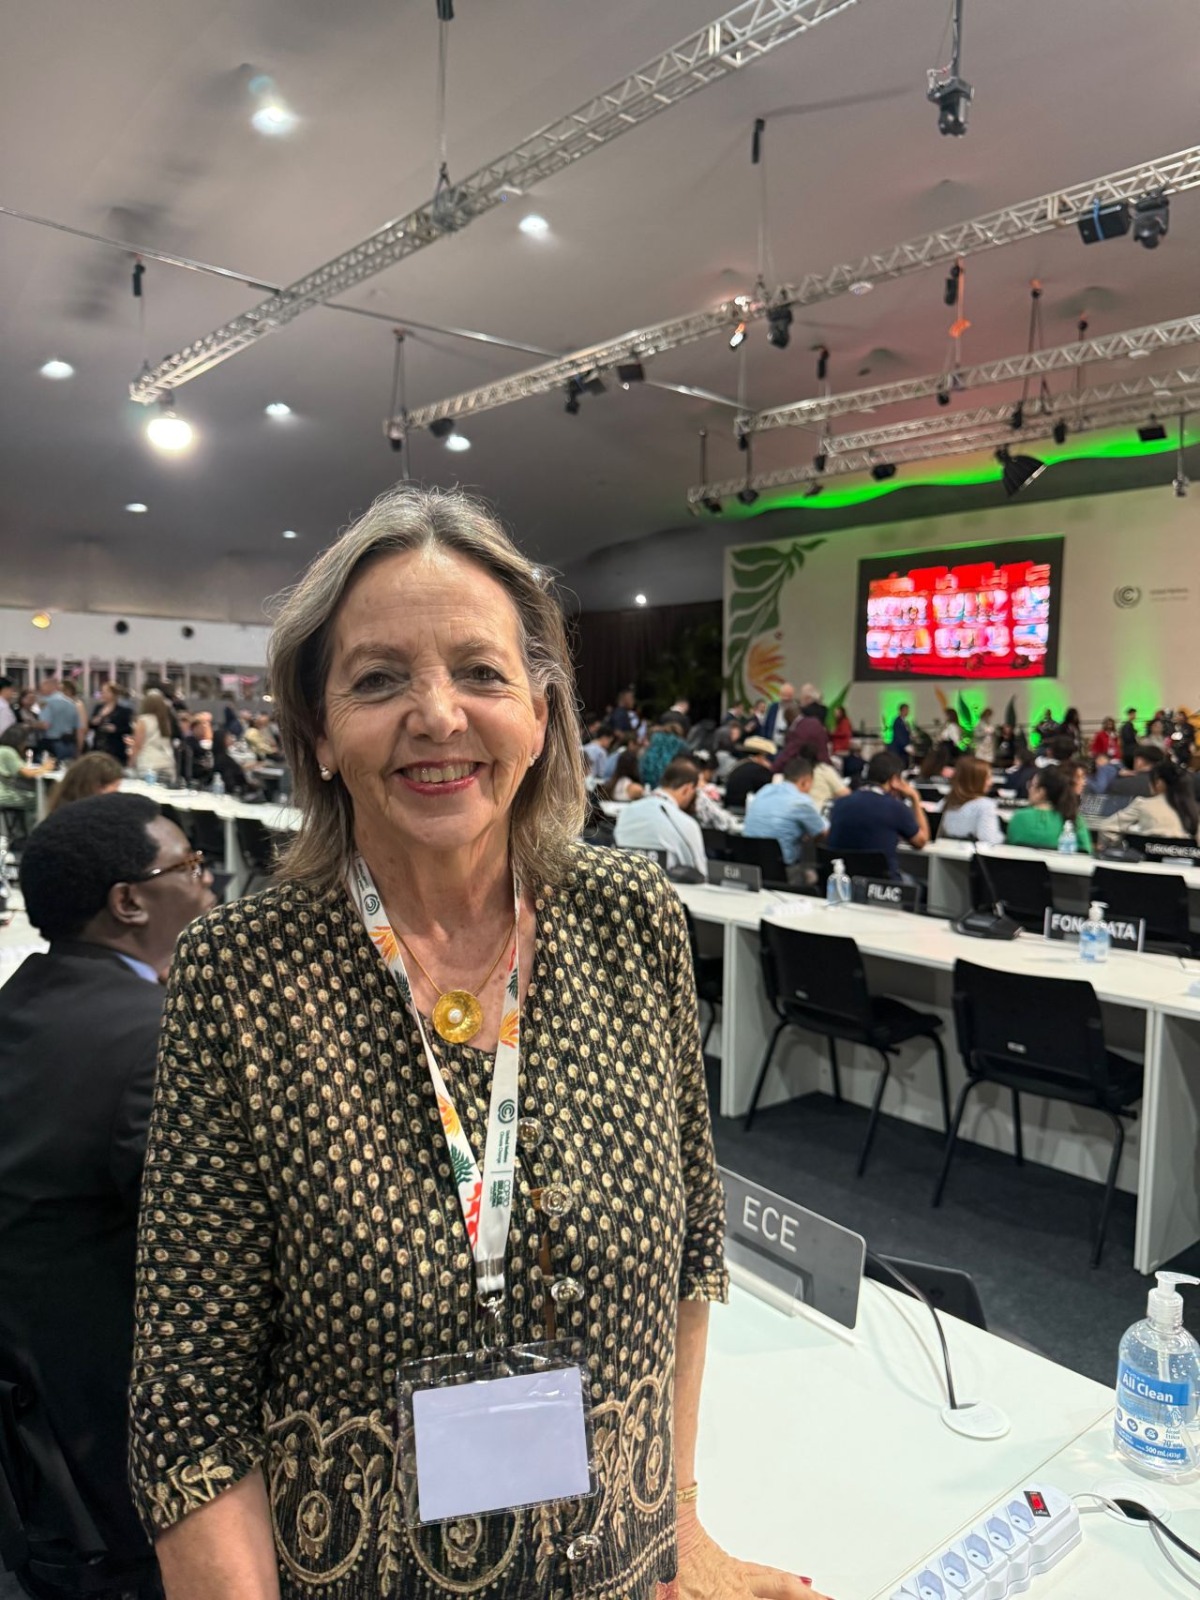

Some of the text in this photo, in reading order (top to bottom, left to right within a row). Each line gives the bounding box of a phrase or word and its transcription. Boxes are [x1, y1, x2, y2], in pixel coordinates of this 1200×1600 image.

[1144, 842, 1200, 859] TURKMENISTA
[867, 883, 902, 902] FILAC
[1051, 913, 1138, 942] FONATA
[743, 1195, 799, 1253] ECE
[1122, 1372, 1136, 1390] All
[1137, 1382, 1174, 1403] Clean
[1145, 1445, 1157, 1455] 500
